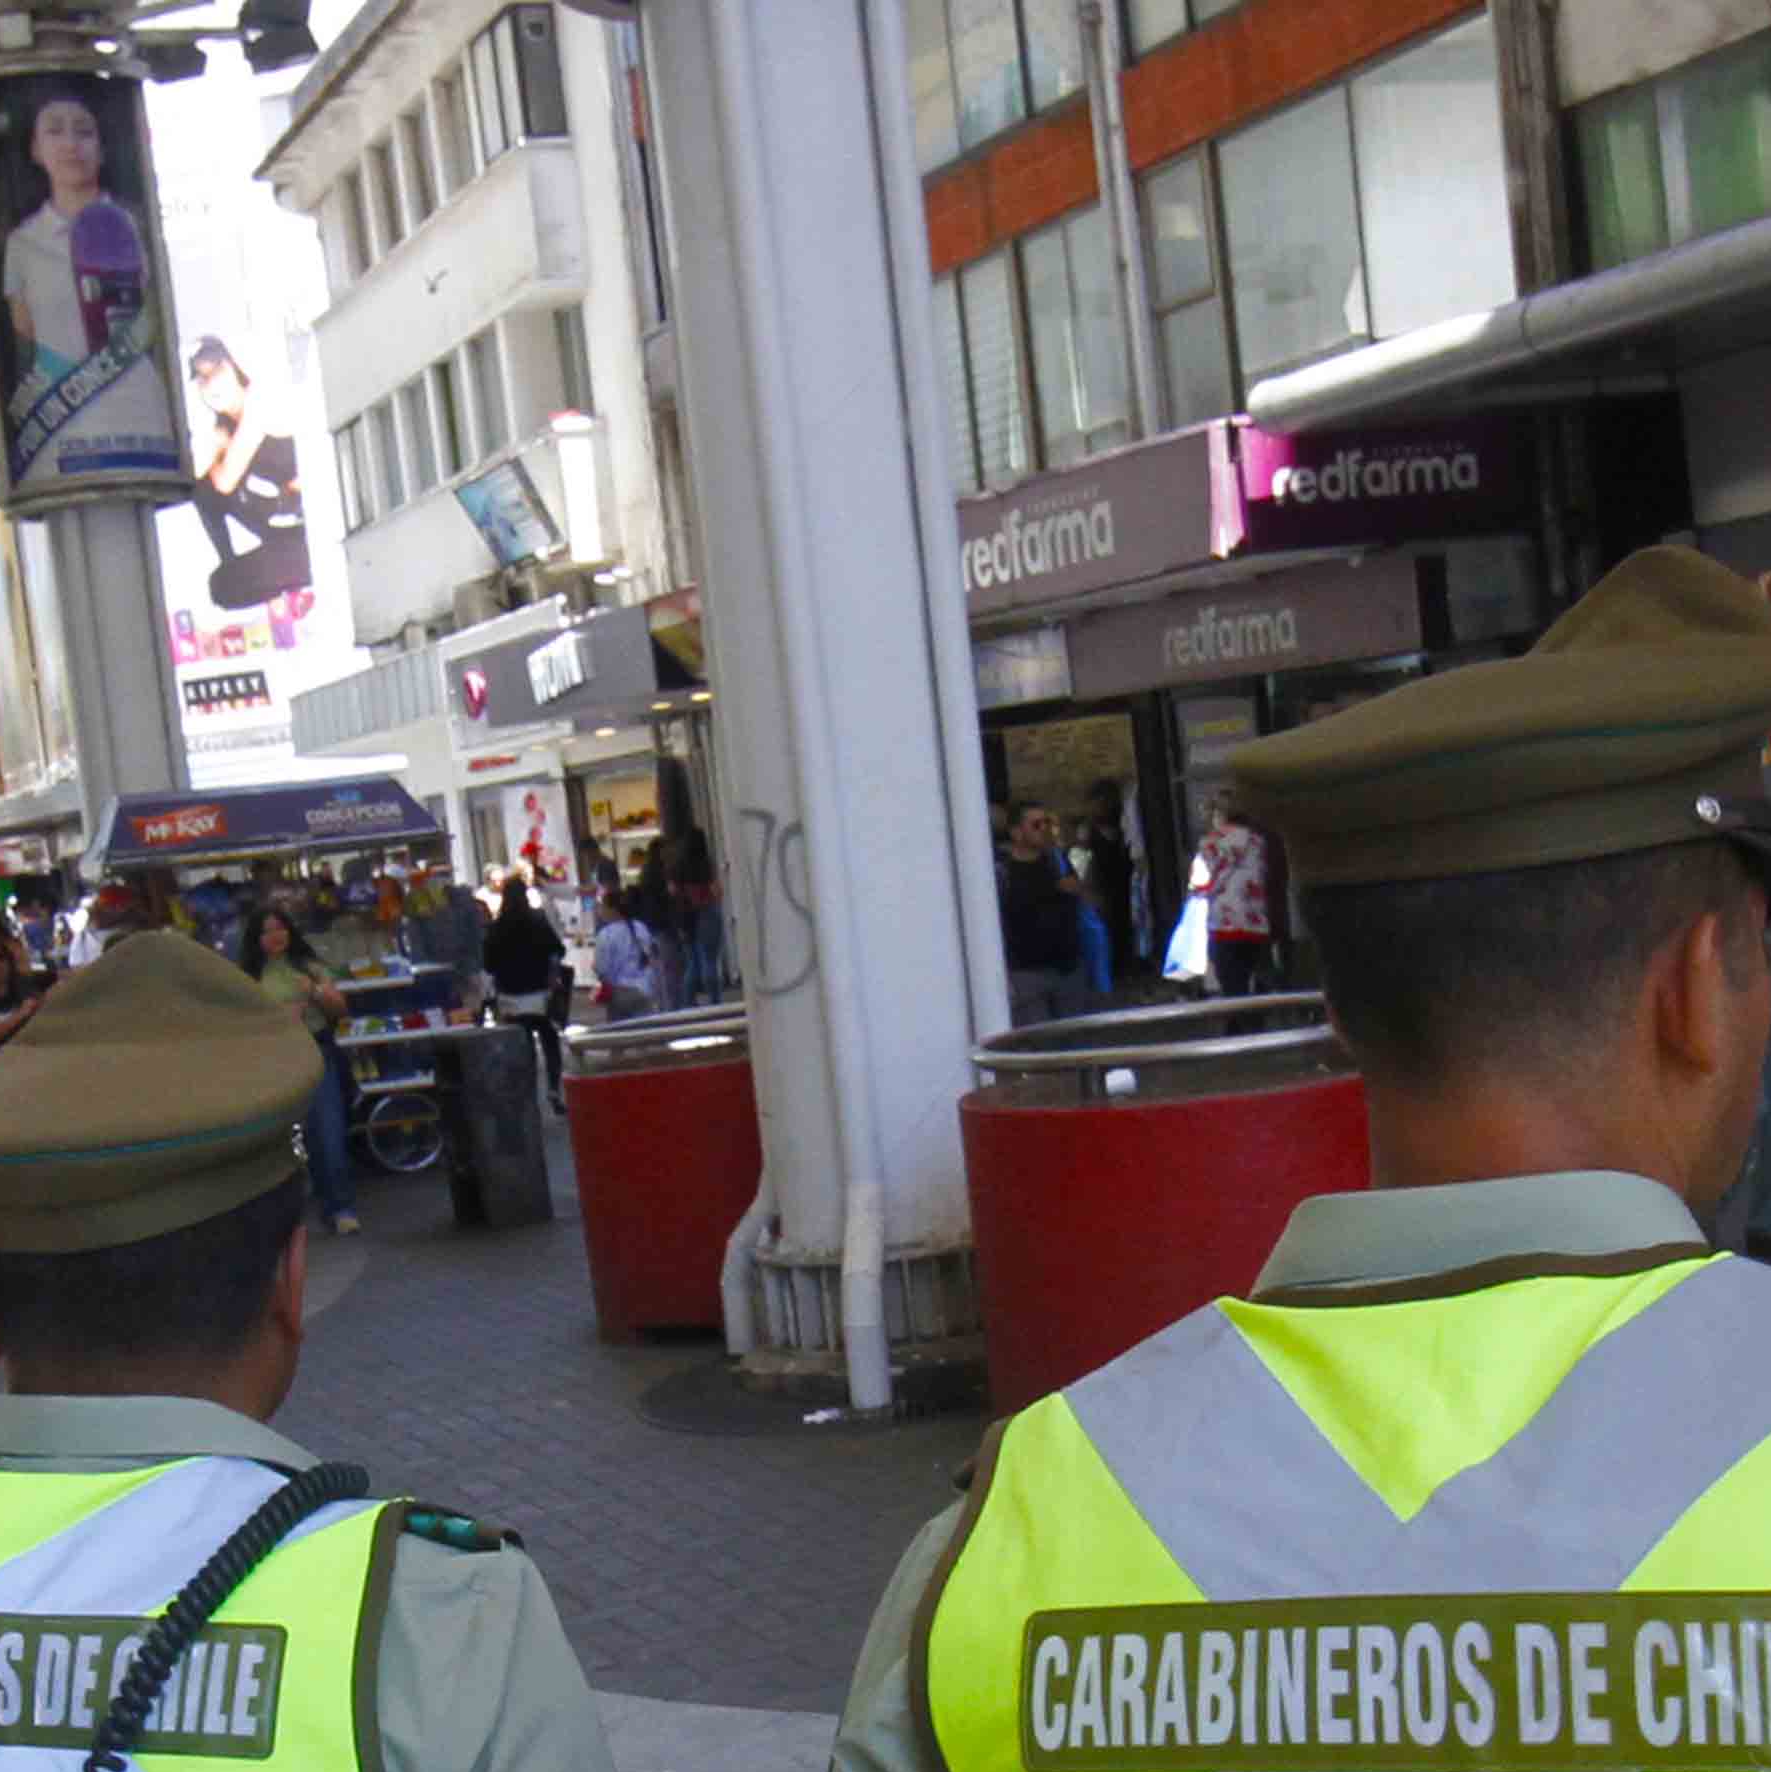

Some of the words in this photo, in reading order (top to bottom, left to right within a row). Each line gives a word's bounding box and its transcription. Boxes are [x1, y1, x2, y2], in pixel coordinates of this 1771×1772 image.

[1271, 449, 1479, 505] redfarma
[961, 500, 1116, 592] redfarma
[1163, 606, 1299, 668] redfarma
[33, 1632, 101, 1729] DE
[1033, 1619, 1496, 1752] CARABINEROS
[1515, 1621, 1614, 1748] DE
